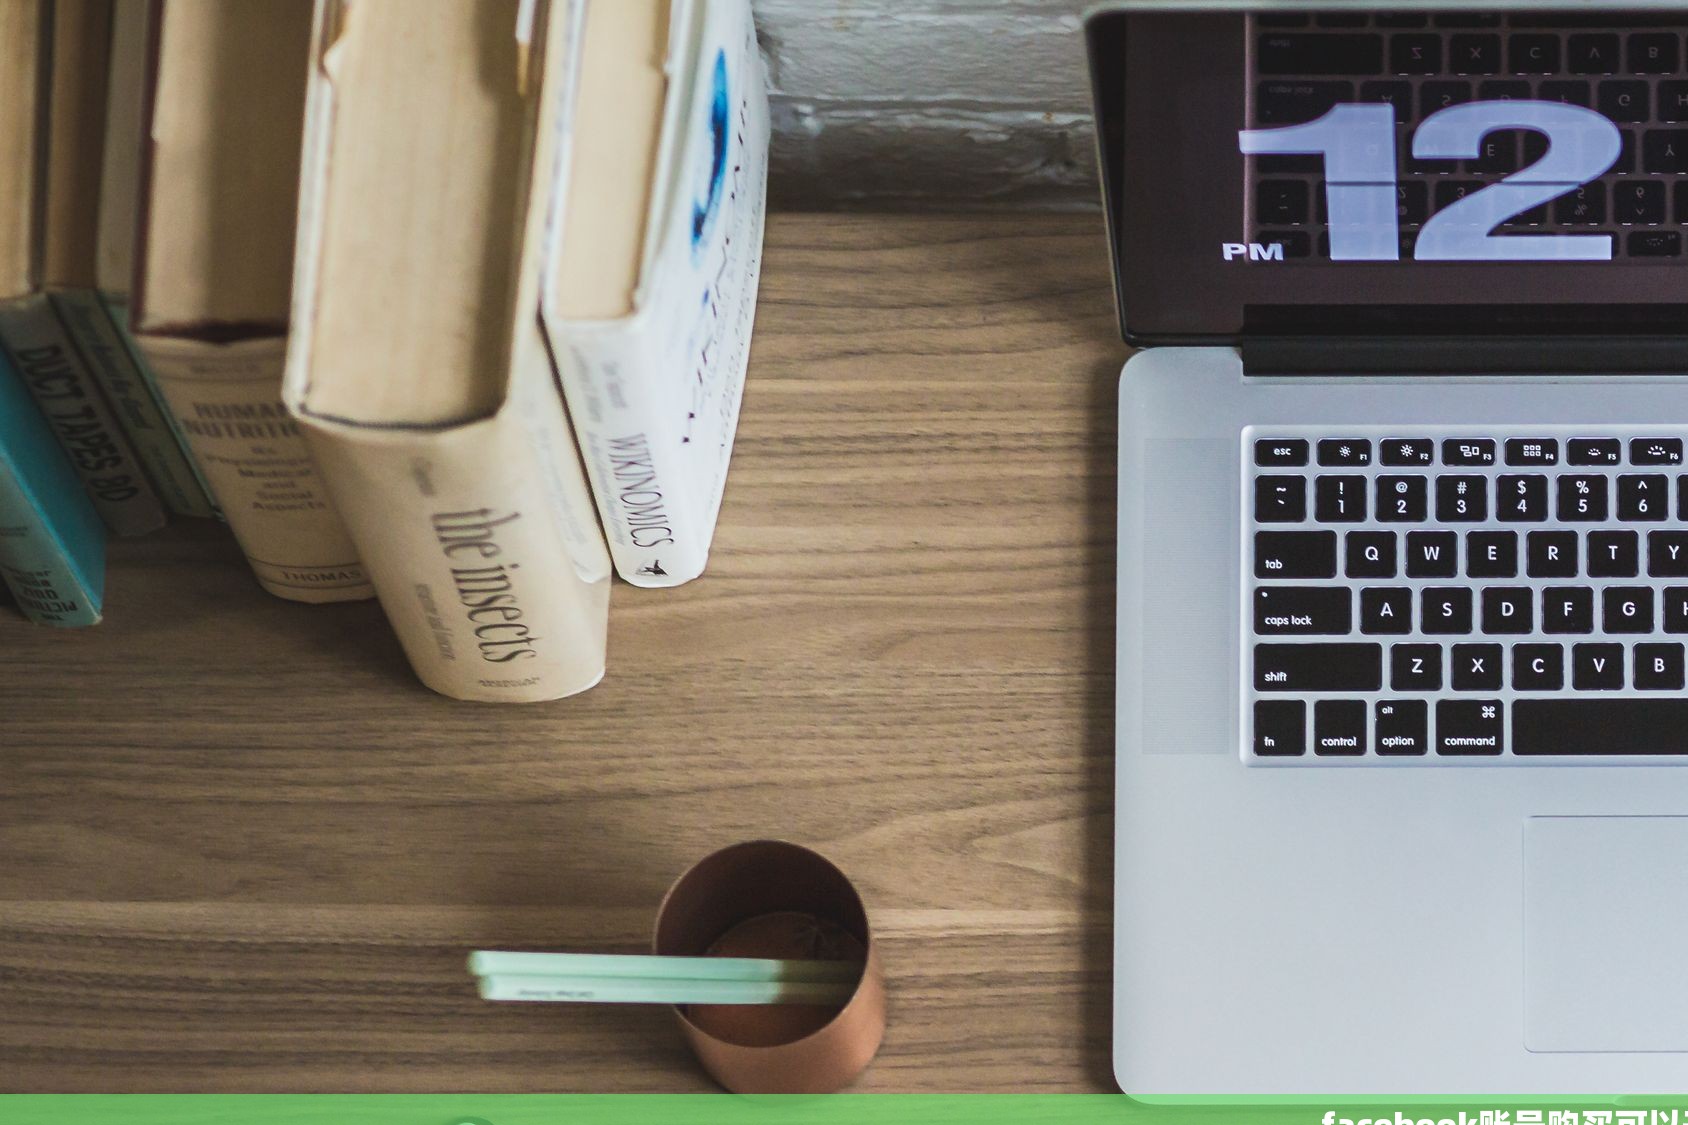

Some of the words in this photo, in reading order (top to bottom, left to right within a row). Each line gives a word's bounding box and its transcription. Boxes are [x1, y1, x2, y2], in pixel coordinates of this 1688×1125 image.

[1238, 100, 1624, 260] 12
[1222, 242, 1284, 261] PM
[1273, 447, 1292, 456] esc
[1359, 453, 1368, 461] F1
[1419, 452, 1429, 460] F2
[1482, 453, 1492, 461] F3
[1544, 453, 1555, 461] F4
[1607, 453, 1617, 461] F5
[1669, 452, 1679, 461] F6
[607, 432, 675, 548] WIKINOMICS
[1396, 499, 1407, 514] 2
[1456, 499, 1467, 514] 3
[1516, 498, 1528, 513] 4
[1577, 498, 1588, 513] 5
[1638, 498, 1648, 513] 6
[431, 508, 521, 560] the
[1264, 558, 1283, 570] tab
[1364, 545, 1379, 561] Q
[1423, 545, 1440, 561] W
[1487, 545, 1497, 561] E
[1547, 545, 1559, 561] R
[1607, 545, 1619, 560] T
[1668, 544, 1680, 560] Y
[451, 563, 542, 663] insects
[1264, 616, 1290, 627] caps
[1290, 614, 1313, 626] lock
[1379, 601, 1394, 617] A
[1442, 602, 1453, 617] S
[1501, 601, 1515, 617] D
[1563, 601, 1573, 617] F
[1622, 601, 1636, 617] G
[1264, 671, 1288, 682] shift
[1411, 658, 1424, 674] Z
[1471, 657, 1485, 673] X
[1531, 657, 1545, 674] C
[1592, 657, 1606, 673] V
[1653, 657, 1665, 673] B
[1381, 705, 1394, 715] alt
[1263, 735, 1275, 747] fn
[1321, 735, 1357, 747] control
[1381, 735, 1415, 748] option
[1444, 735, 1496, 746] command
